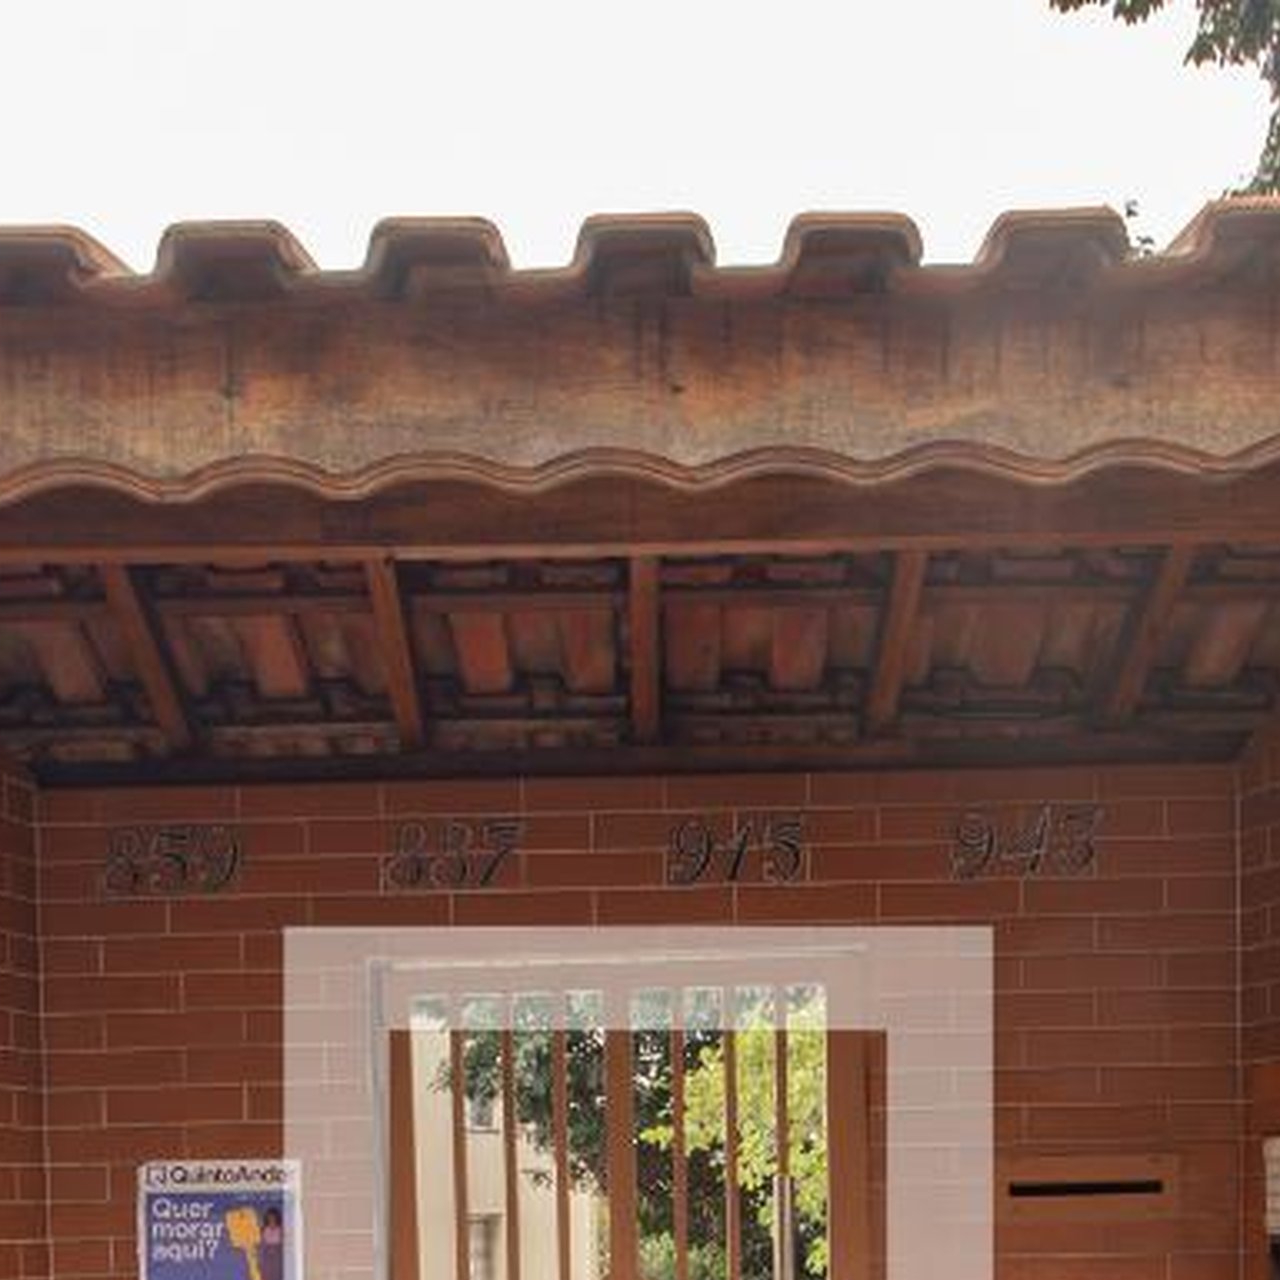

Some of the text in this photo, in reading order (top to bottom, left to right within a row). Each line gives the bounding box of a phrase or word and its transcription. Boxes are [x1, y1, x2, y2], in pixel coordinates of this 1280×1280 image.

[152, 1199, 214, 1219] Quer
[152, 1222, 224, 1239] morar
[152, 1241, 219, 1262] aqui?
